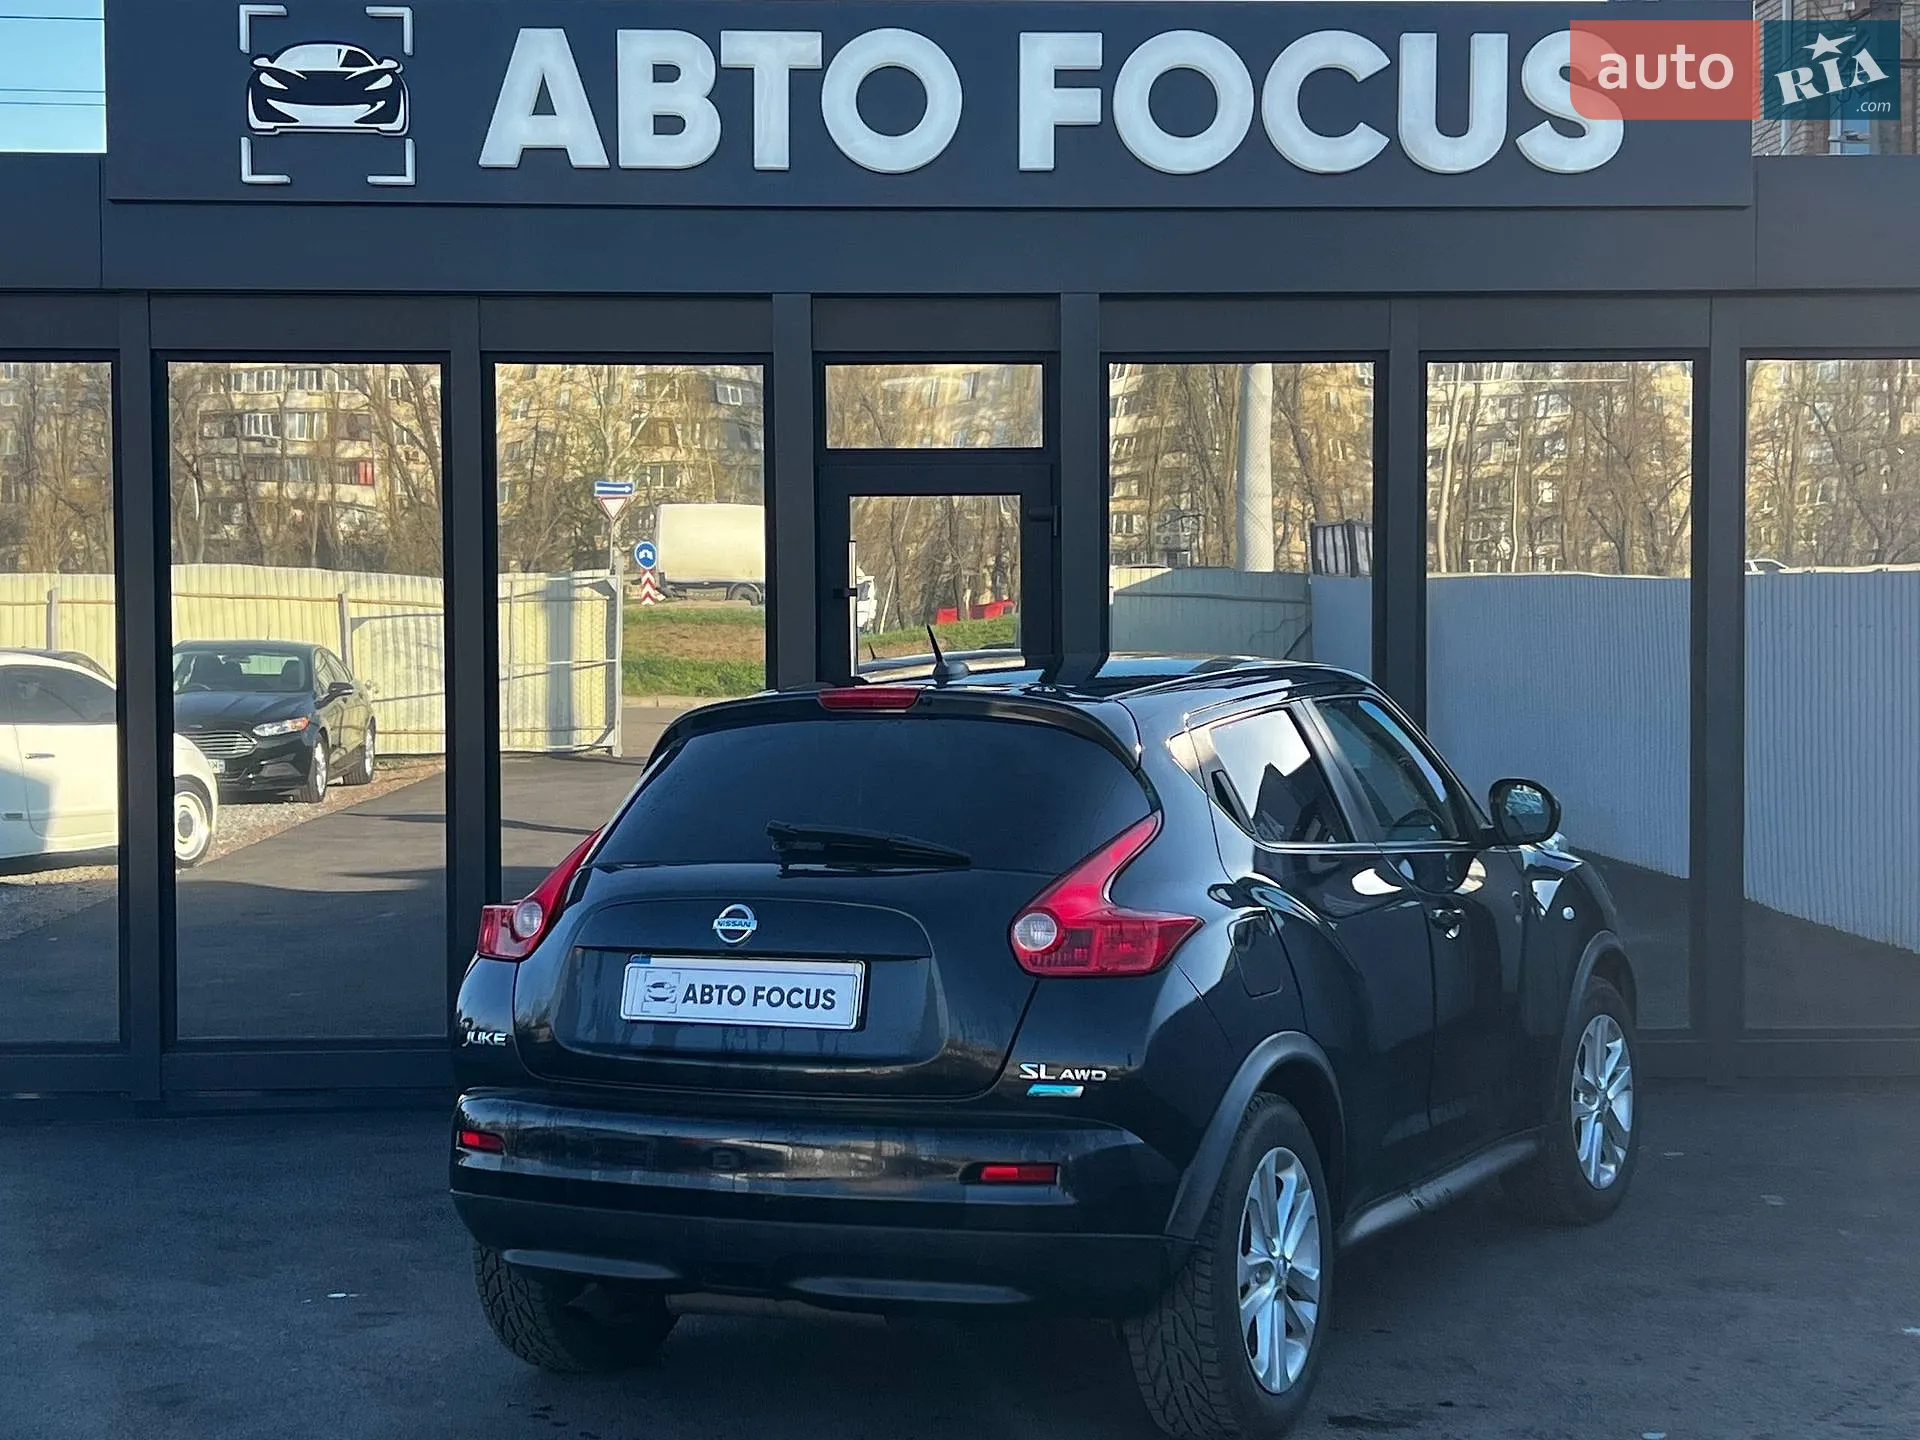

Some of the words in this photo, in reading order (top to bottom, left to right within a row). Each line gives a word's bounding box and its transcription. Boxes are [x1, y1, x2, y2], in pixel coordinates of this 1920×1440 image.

[1018, 28, 1627, 175] FOCUS
[717, 919, 752, 928] NISSAN
[752, 986, 836, 1010] FOCUS
[461, 1031, 507, 1047] JUKE
[1019, 1063, 1056, 1080] SL
[1059, 1068, 1107, 1081] AWD
